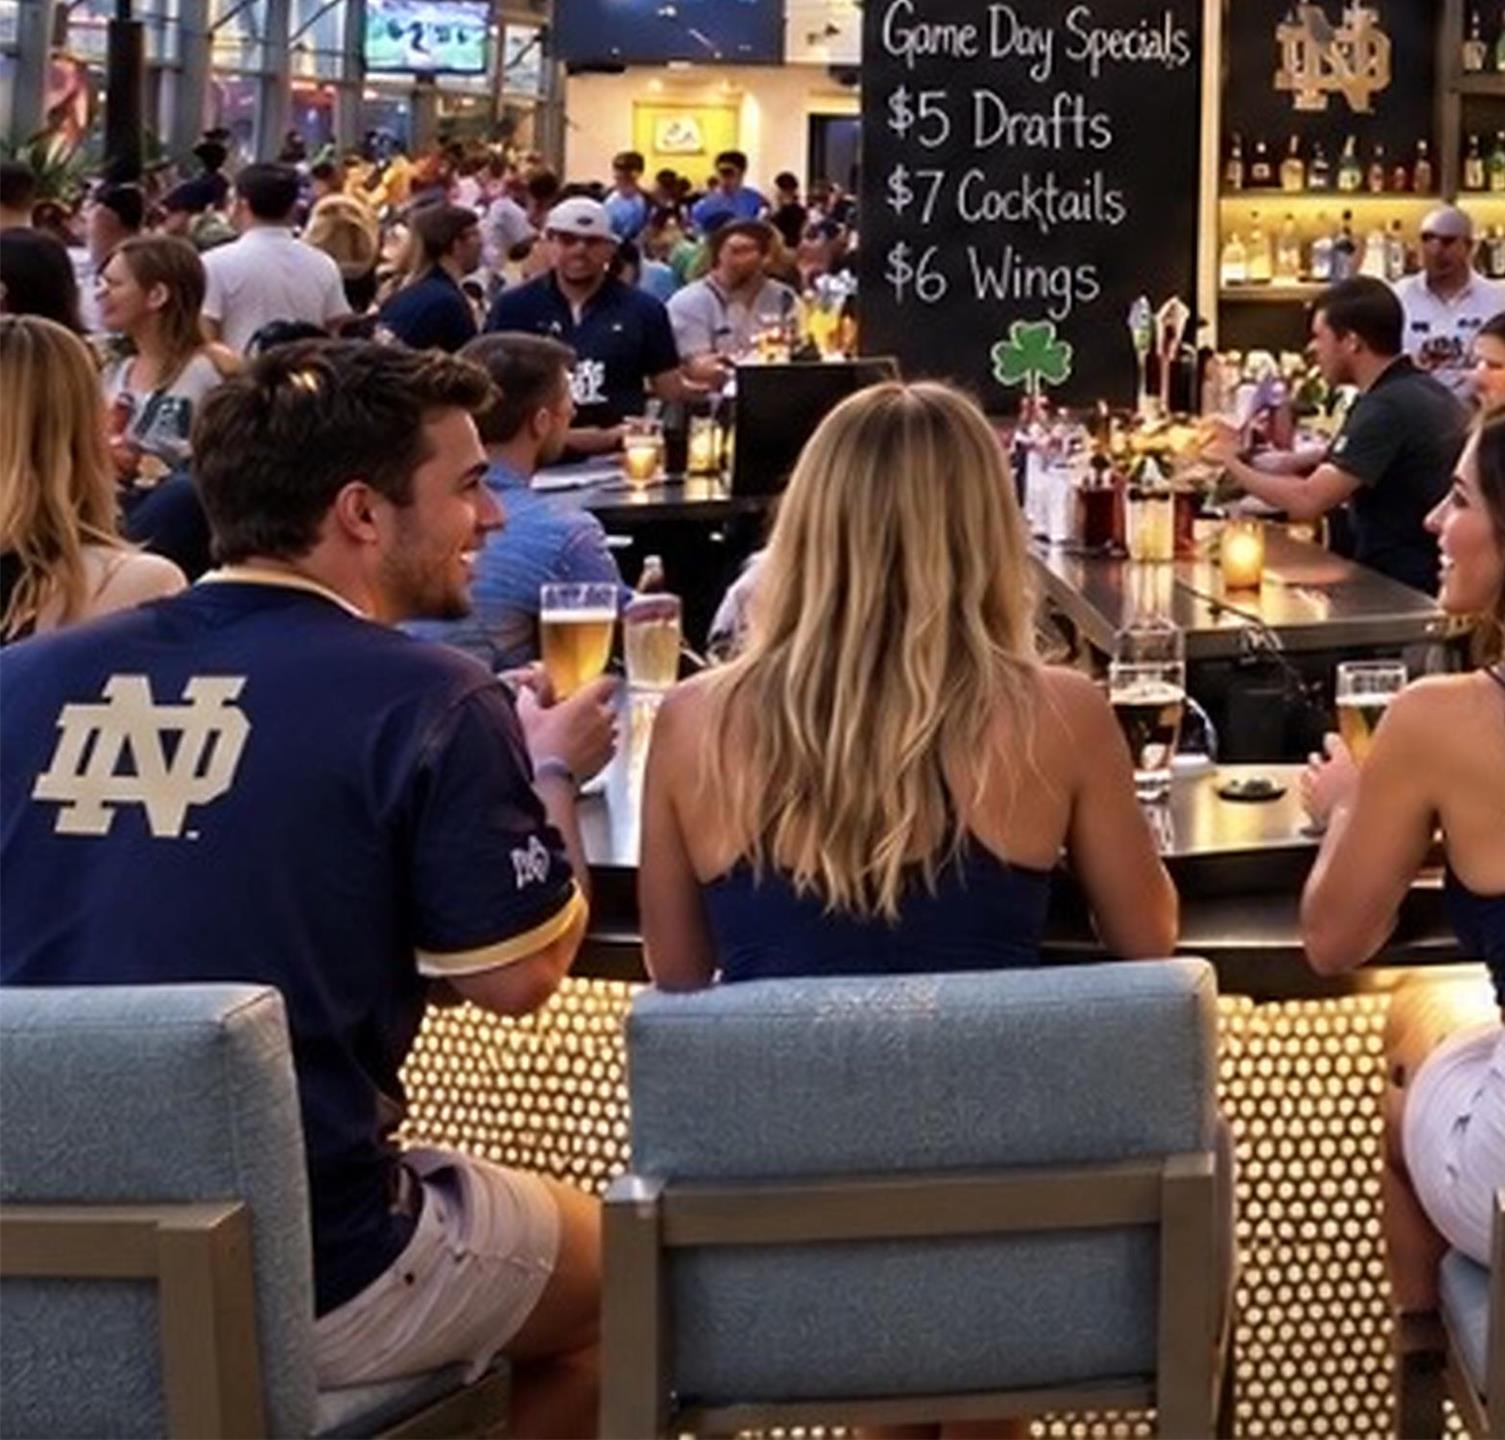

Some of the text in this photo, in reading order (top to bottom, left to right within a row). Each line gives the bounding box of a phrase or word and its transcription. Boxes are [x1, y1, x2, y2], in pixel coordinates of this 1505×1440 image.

[988, 3, 1054, 83] Day
[1065, 6, 1191, 79] Specials
[887, 84, 1112, 149] $5 Drafts
[887, 163, 1127, 234] $7 Cocktails
[885, 241, 1100, 320] $6 Wings
[31, 674, 252, 837] ND
